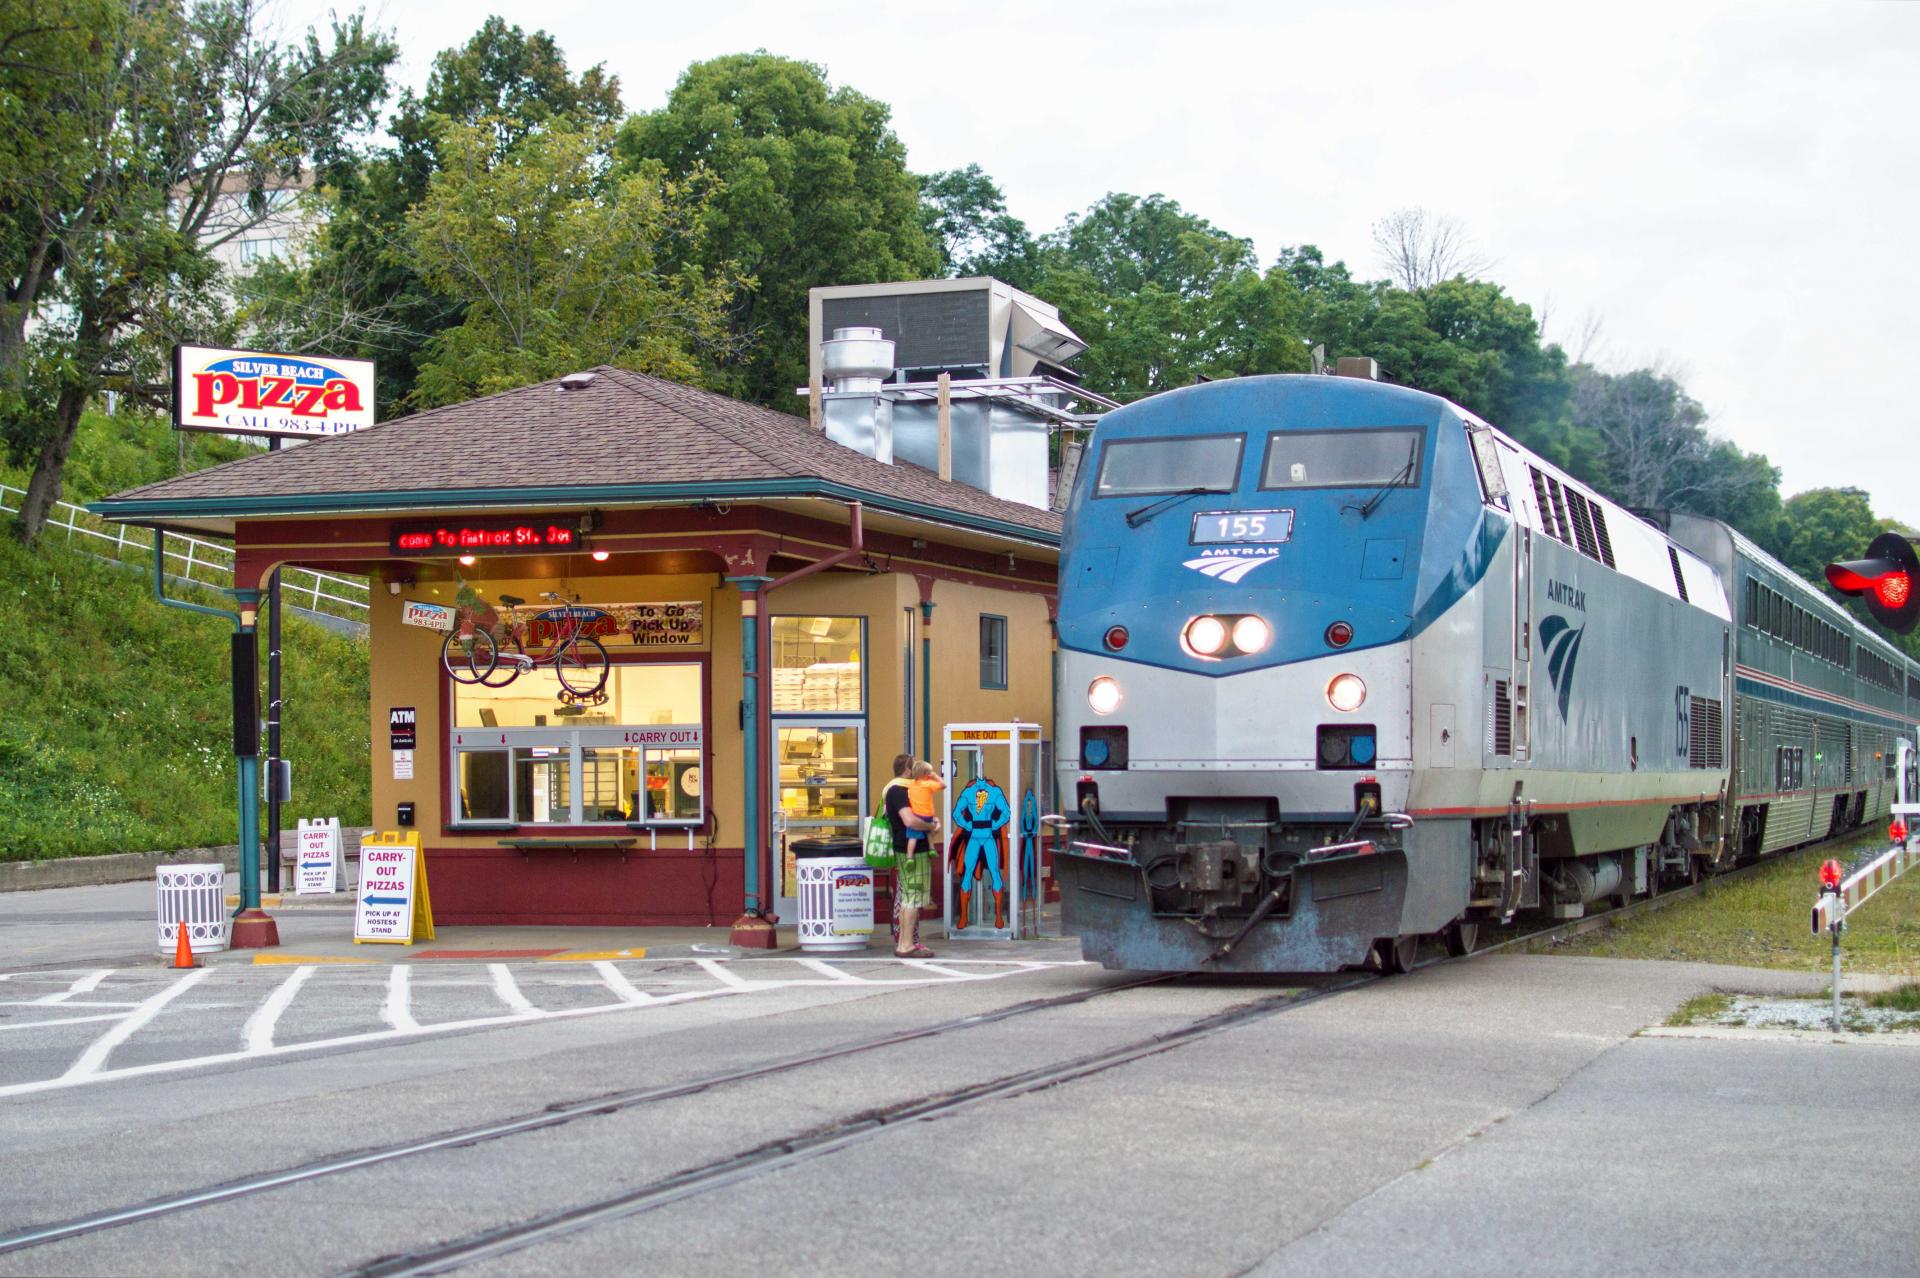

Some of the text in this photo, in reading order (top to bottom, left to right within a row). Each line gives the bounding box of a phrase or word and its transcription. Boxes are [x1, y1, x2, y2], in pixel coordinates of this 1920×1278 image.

[232, 360, 324, 380] SILVER BEACH
[192, 371, 364, 418] pizza
[225, 414, 269, 428] CALL
[1218, 516, 1266, 537] 155
[515, 527, 540, 544] St.
[1201, 547, 1280, 556] AMTRAK
[1547, 578, 1586, 612] AMTRAK
[637, 604, 686, 617] To Go
[632, 619, 689, 632] Pick Up
[632, 633, 690, 645] Window
[390, 710, 415, 724] ATM
[1674, 684, 1688, 757] 155
[632, 732, 691, 743] CARRY OUT
[963, 731, 998, 739] TAKE OUT
[368, 852, 406, 861] CARRY-
[376, 867, 397, 876] OUT
[366, 881, 405, 891] PIZZAS
[835, 876, 870, 889] pizza
